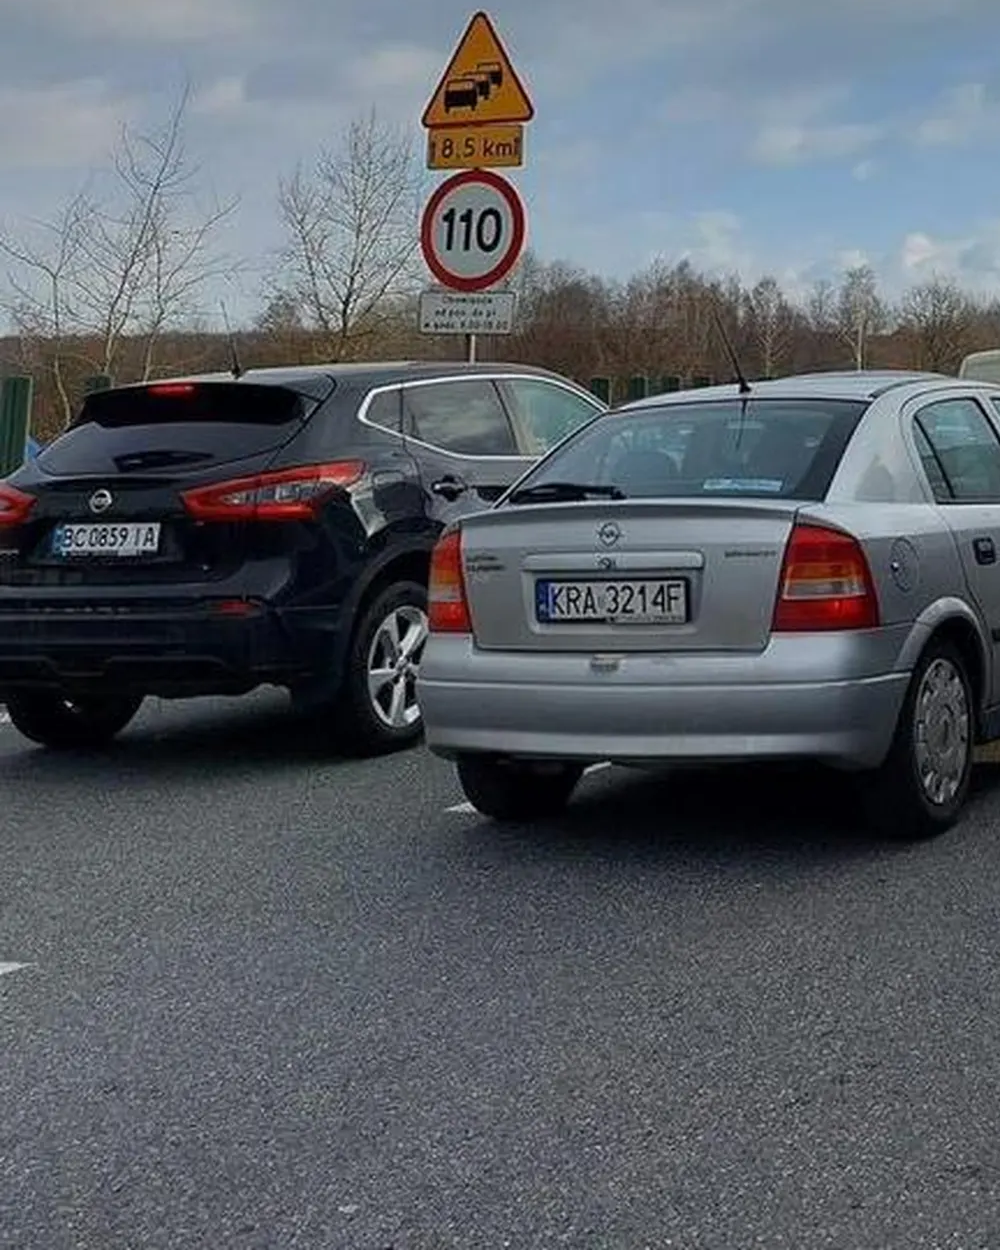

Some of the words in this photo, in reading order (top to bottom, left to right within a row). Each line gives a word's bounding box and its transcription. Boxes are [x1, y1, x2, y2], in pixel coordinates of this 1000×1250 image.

[482, 137, 513, 158] km
[442, 207, 503, 253] 110
[551, 585, 597, 615] KRA
[605, 583, 682, 614] 3214F
